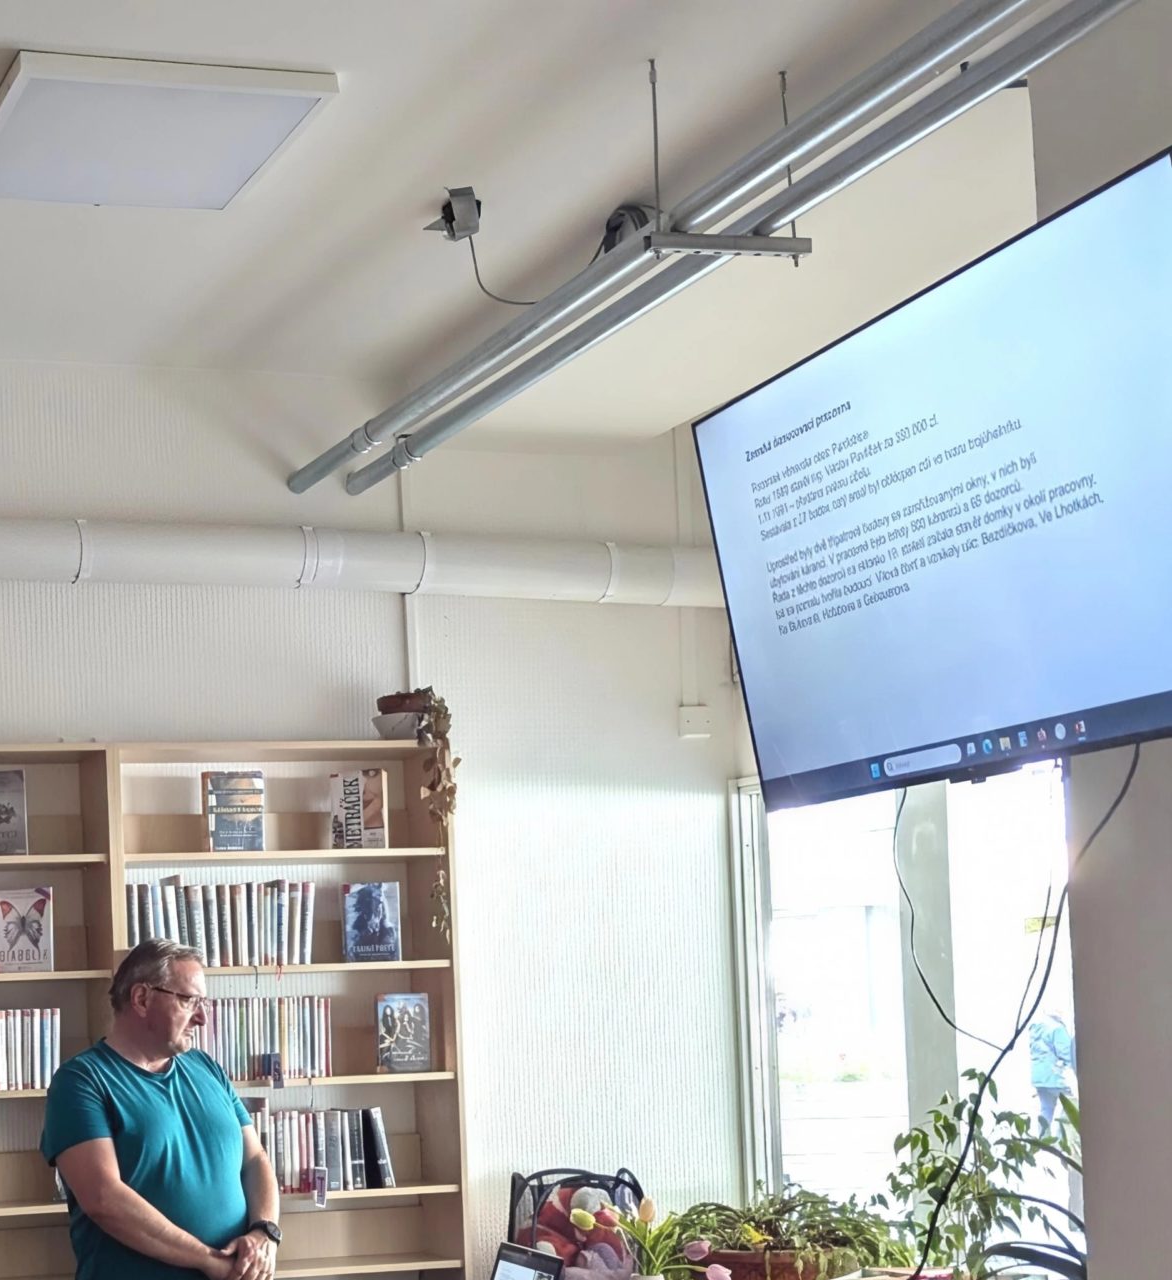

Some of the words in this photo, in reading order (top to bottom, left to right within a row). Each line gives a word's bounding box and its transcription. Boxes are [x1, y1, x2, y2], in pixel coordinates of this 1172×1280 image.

[998, 460, 1018, 477] nich
[983, 505, 1012, 524] domky
[1023, 490, 1045, 509] okolí
